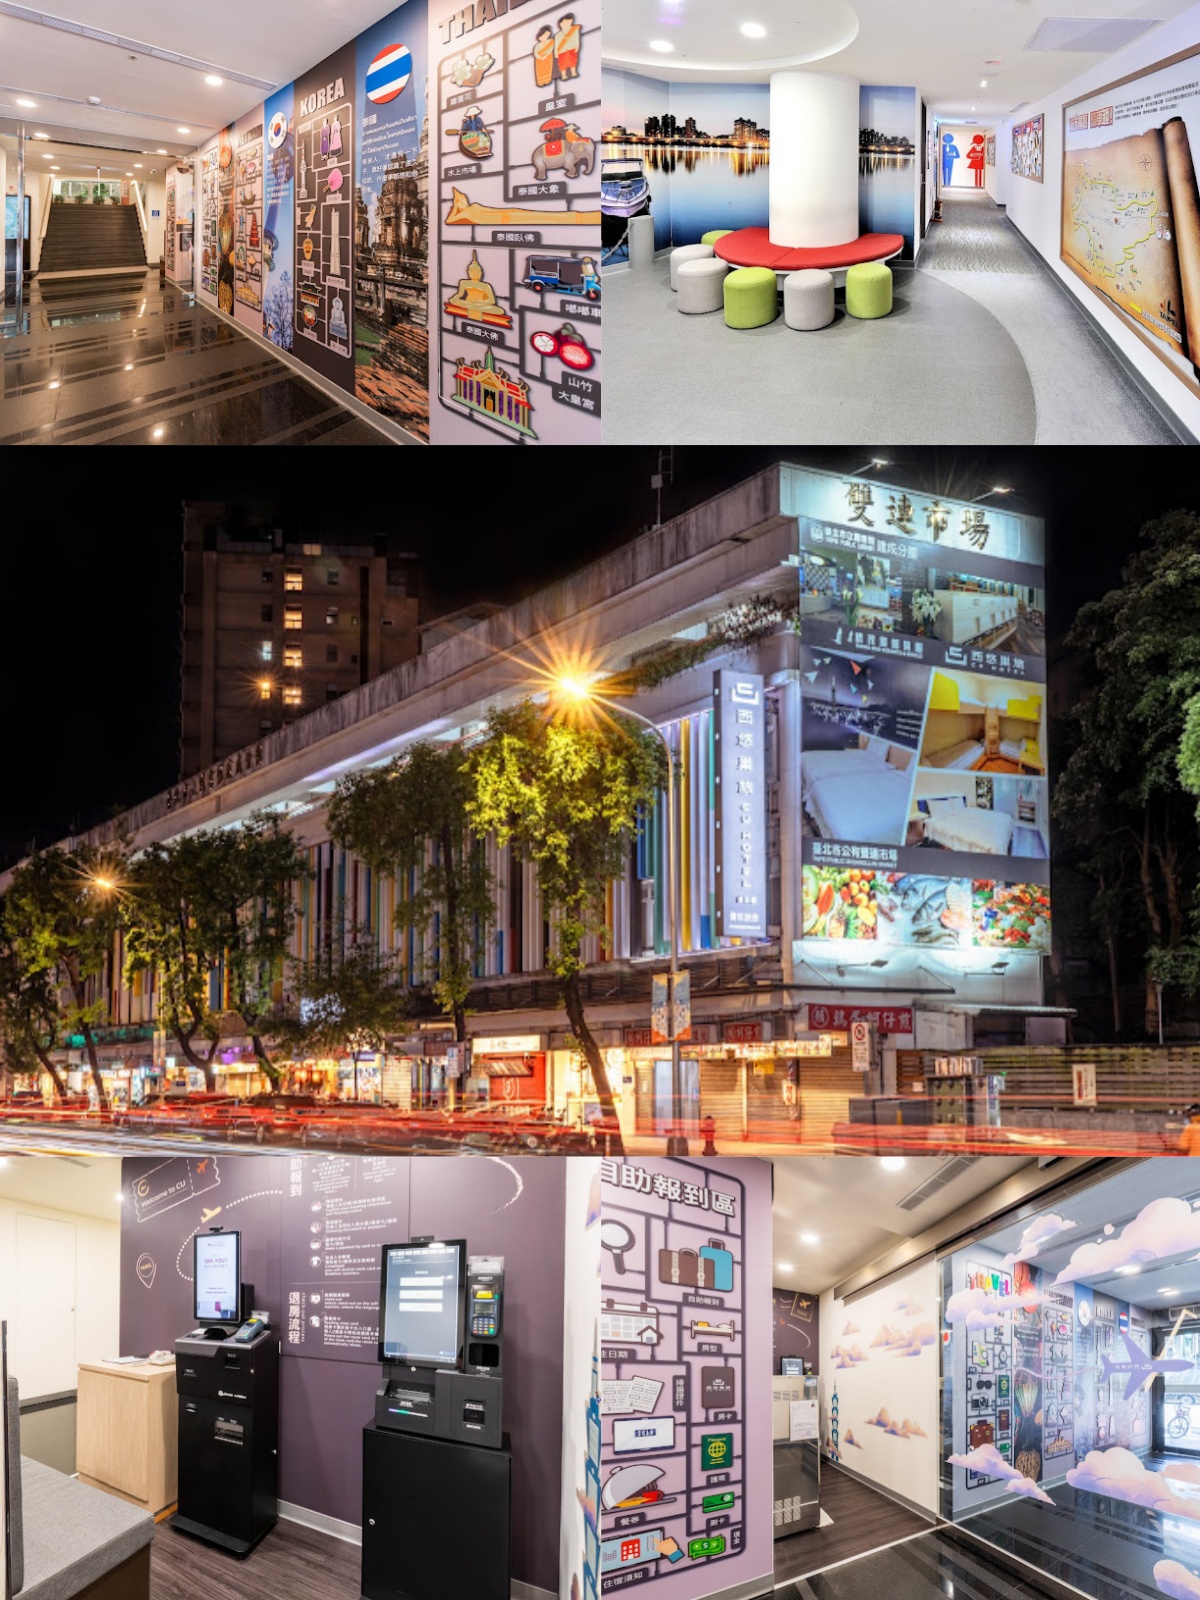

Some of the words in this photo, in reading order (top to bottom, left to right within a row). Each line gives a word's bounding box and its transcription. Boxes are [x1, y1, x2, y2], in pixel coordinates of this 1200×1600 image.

[301, 77, 345, 118] KOREA
[447, 165, 477, 177] 水上市場
[518, 184, 560, 196] 泰國大象
[466, 325, 499, 341] 泰國大佛
[568, 376, 593, 392] 山竹
[558, 390, 596, 411] 大皇宮
[847, 481, 991, 551] 雙連市場
[141, 1190, 168, 1207] Welcome
[176, 1180, 186, 1190] CU
[601, 1160, 736, 1217] 自助報到區
[688, 1295, 720, 1307] 自助報到
[288, 1291, 300, 1344] 退房流程
[701, 1344, 718, 1352] 房型
[620, 1516, 640, 1527] 餐券
[603, 1571, 643, 1589] 住宿須知
